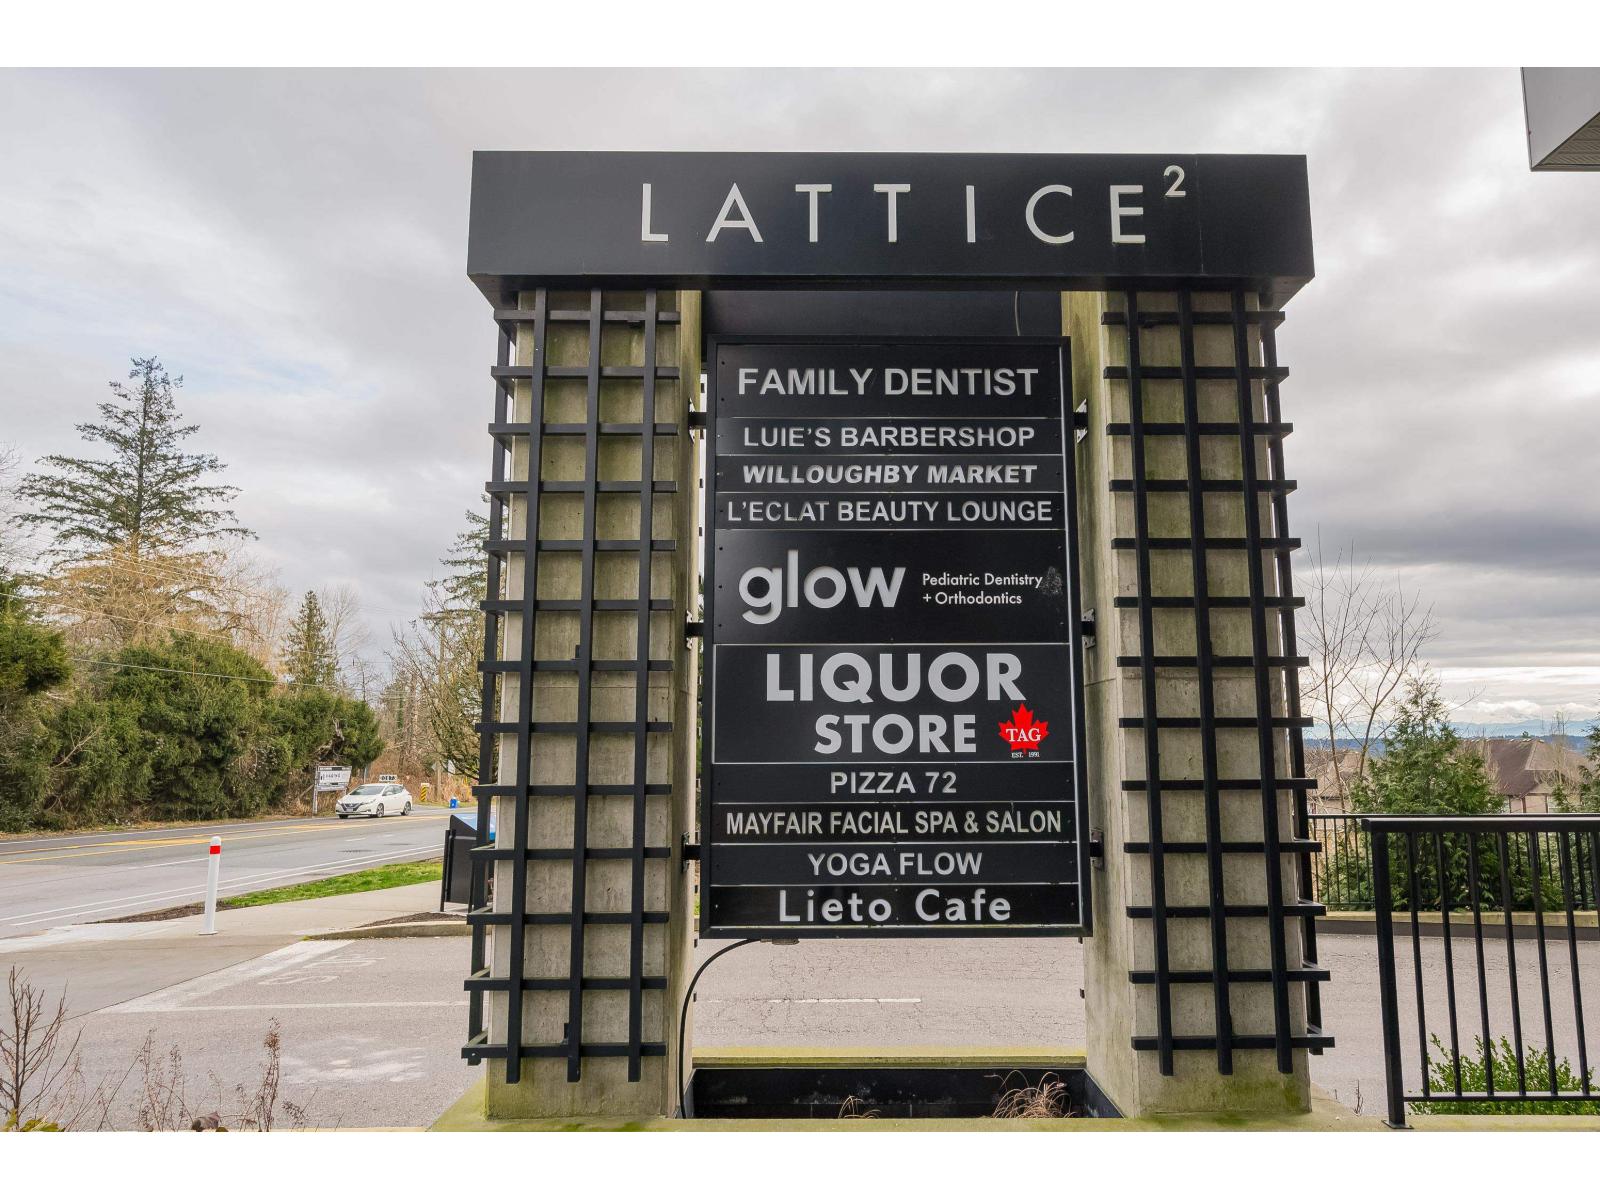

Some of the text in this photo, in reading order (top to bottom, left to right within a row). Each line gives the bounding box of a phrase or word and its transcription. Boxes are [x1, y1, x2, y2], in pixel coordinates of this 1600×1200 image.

[738, 367, 1039, 396] FAMILY DENTIST
[743, 426, 1035, 447] LUIE'S BARBERSHOP
[742, 464, 1038, 484] WILLOUGHBY MARKET
[727, 500, 1053, 522] L'ECLAT BEAUTY LOUNGE
[738, 549, 906, 625] glow
[922, 571, 1044, 589] Pediatric Dentistry
[921, 590, 1023, 605] + Orthodontics
[766, 651, 1027, 704] LIQUOR
[813, 713, 977, 755] STORE
[1004, 726, 1042, 744] TAG
[830, 771, 957, 794] PIZZA 72
[726, 810, 1061, 835] MAYFAIR FACIAL SPA & SALON
[808, 852, 983, 876] YOGA FLOW
[778, 888, 1011, 923] Lieto Cafe
